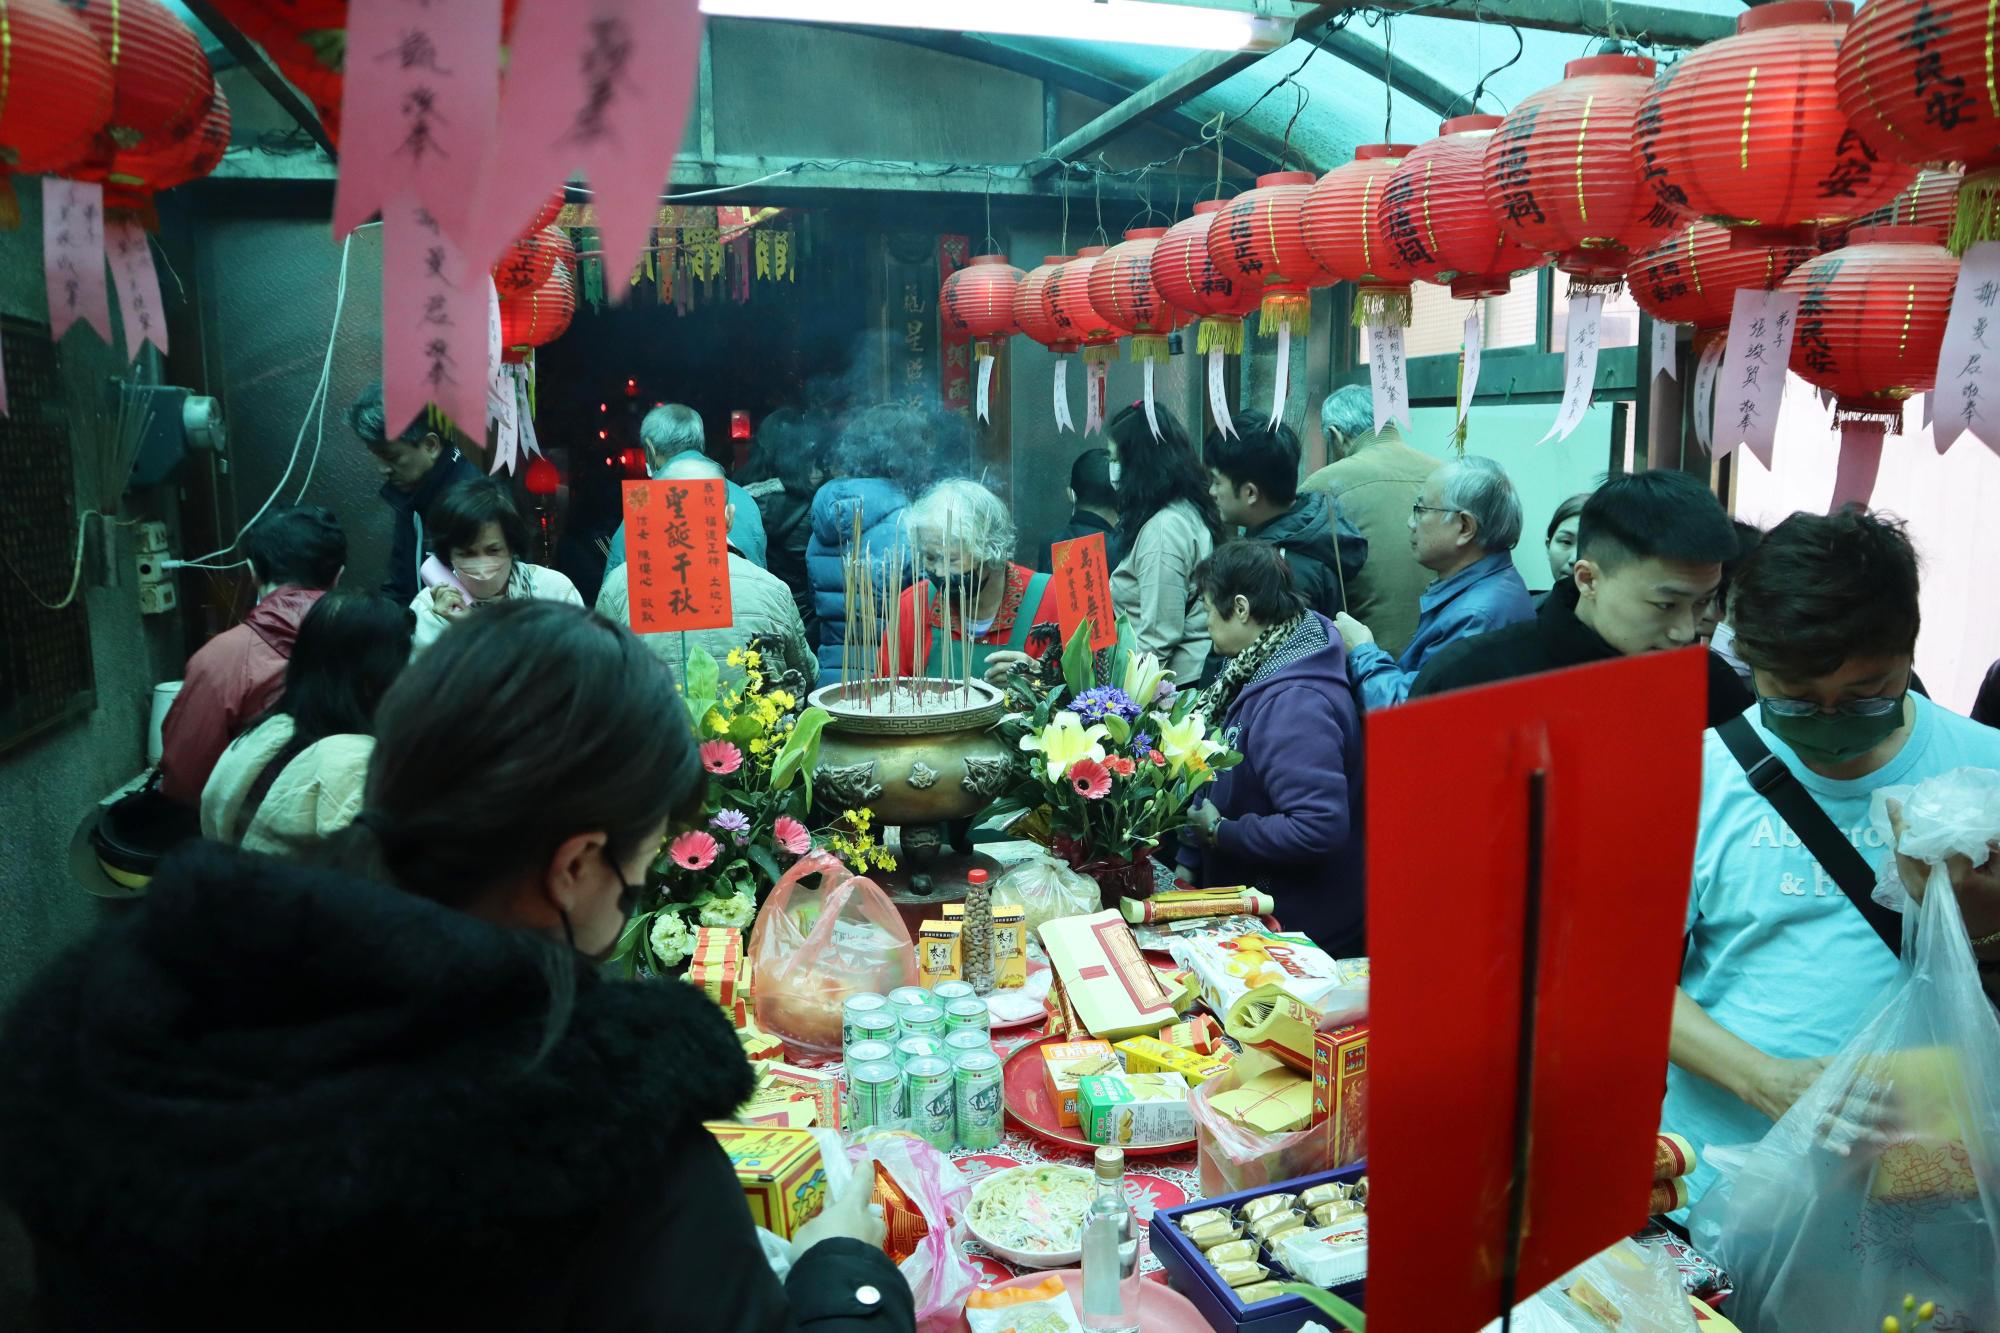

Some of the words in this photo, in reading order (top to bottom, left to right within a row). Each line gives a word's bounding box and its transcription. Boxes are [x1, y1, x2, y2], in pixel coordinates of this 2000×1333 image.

[1495, 102, 1546, 228] 福德祠
[1229, 200, 1264, 277] 福德正神
[1798, 258, 1843, 375] 國泰民安
[664, 486, 699, 615] 聖誕千秋
